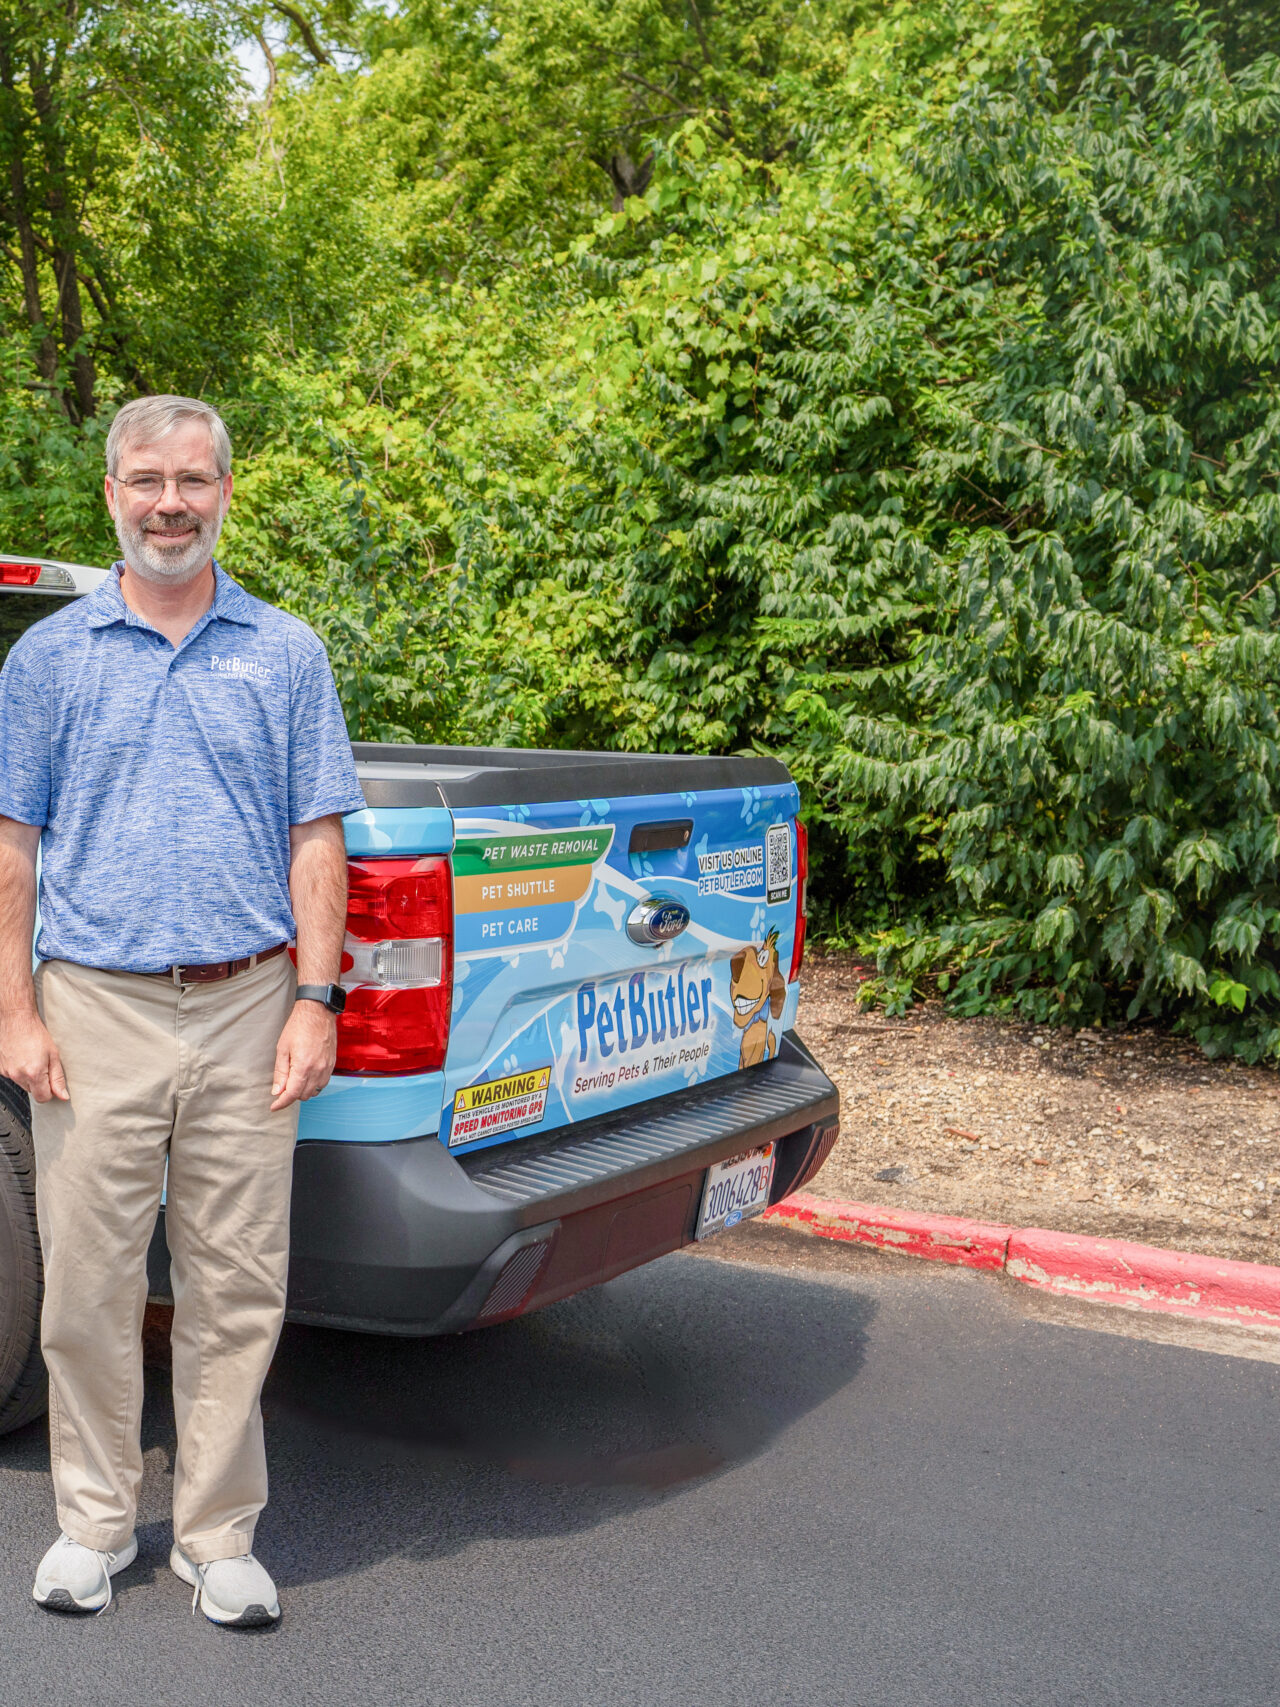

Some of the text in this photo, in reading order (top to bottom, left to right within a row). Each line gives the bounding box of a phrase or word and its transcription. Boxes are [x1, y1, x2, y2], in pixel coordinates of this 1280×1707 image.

[210, 655, 271, 679] PetButler
[482, 838, 599, 860] PET WASTE REMOVAL
[698, 848, 763, 871] VISIT US ONLINE
[481, 879, 555, 900] PET SHUTTLE
[699, 869, 763, 893] PETBUTLER.COM
[482, 917, 539, 938] PET CARE
[659, 911, 684, 933] Ford
[577, 962, 712, 1063] PetButler
[574, 1042, 710, 1094] Serving Pets & Their People
[472, 1075, 535, 1106] WARNING
[454, 1100, 543, 1136] SPEED MONITORING GPS
[459, 1112, 471, 1120] THIS
[472, 1107, 494, 1117] VEHICLE
[501, 1096, 531, 1110] MONITORED
